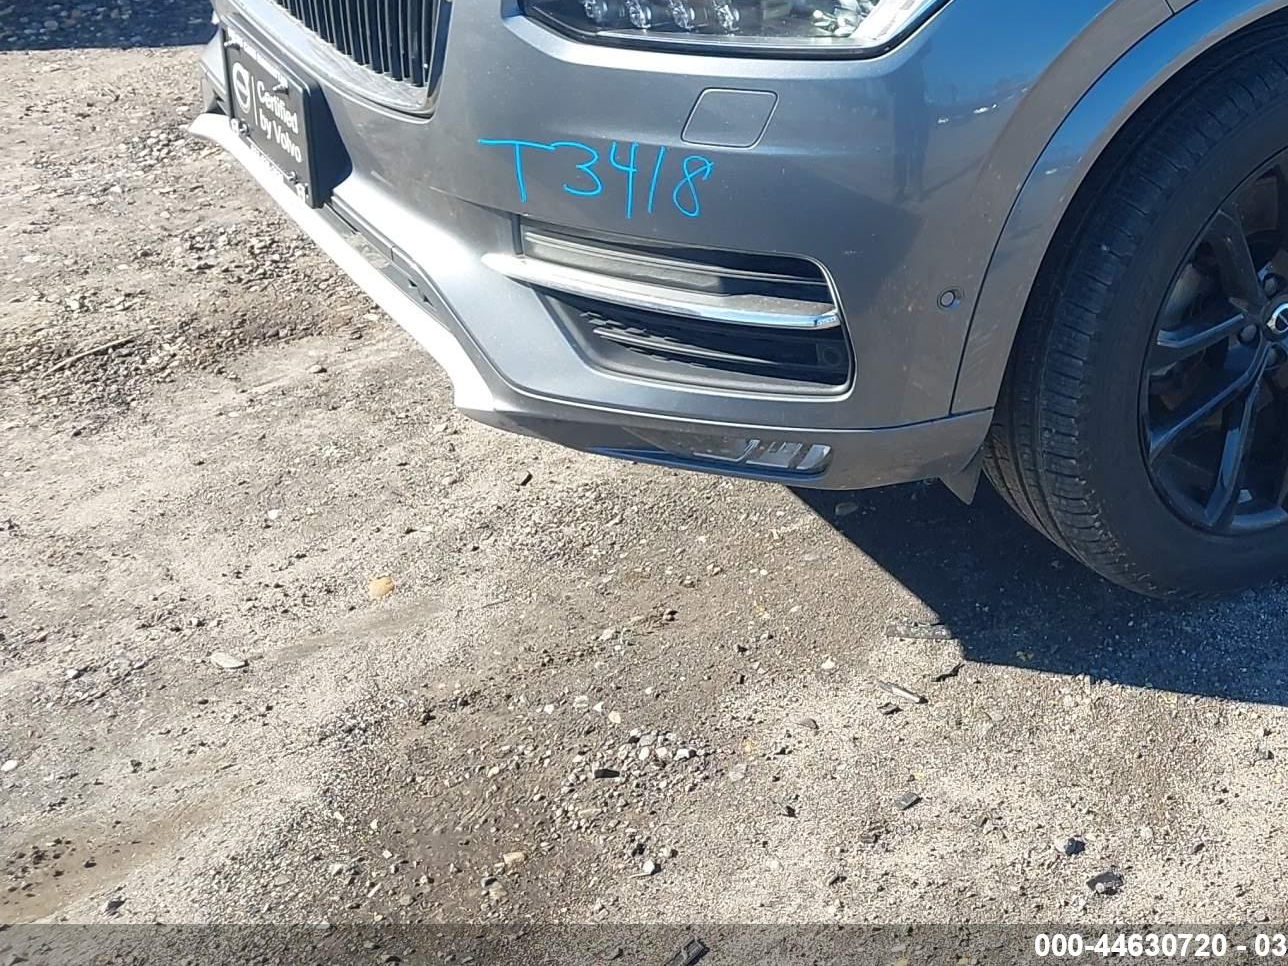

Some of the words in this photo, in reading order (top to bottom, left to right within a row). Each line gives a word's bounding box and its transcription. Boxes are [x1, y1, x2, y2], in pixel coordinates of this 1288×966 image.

[257, 81, 299, 134] Certified
[259, 108, 272, 140] by
[273, 119, 302, 163] Volvo
[477, 138, 715, 219] T3418
